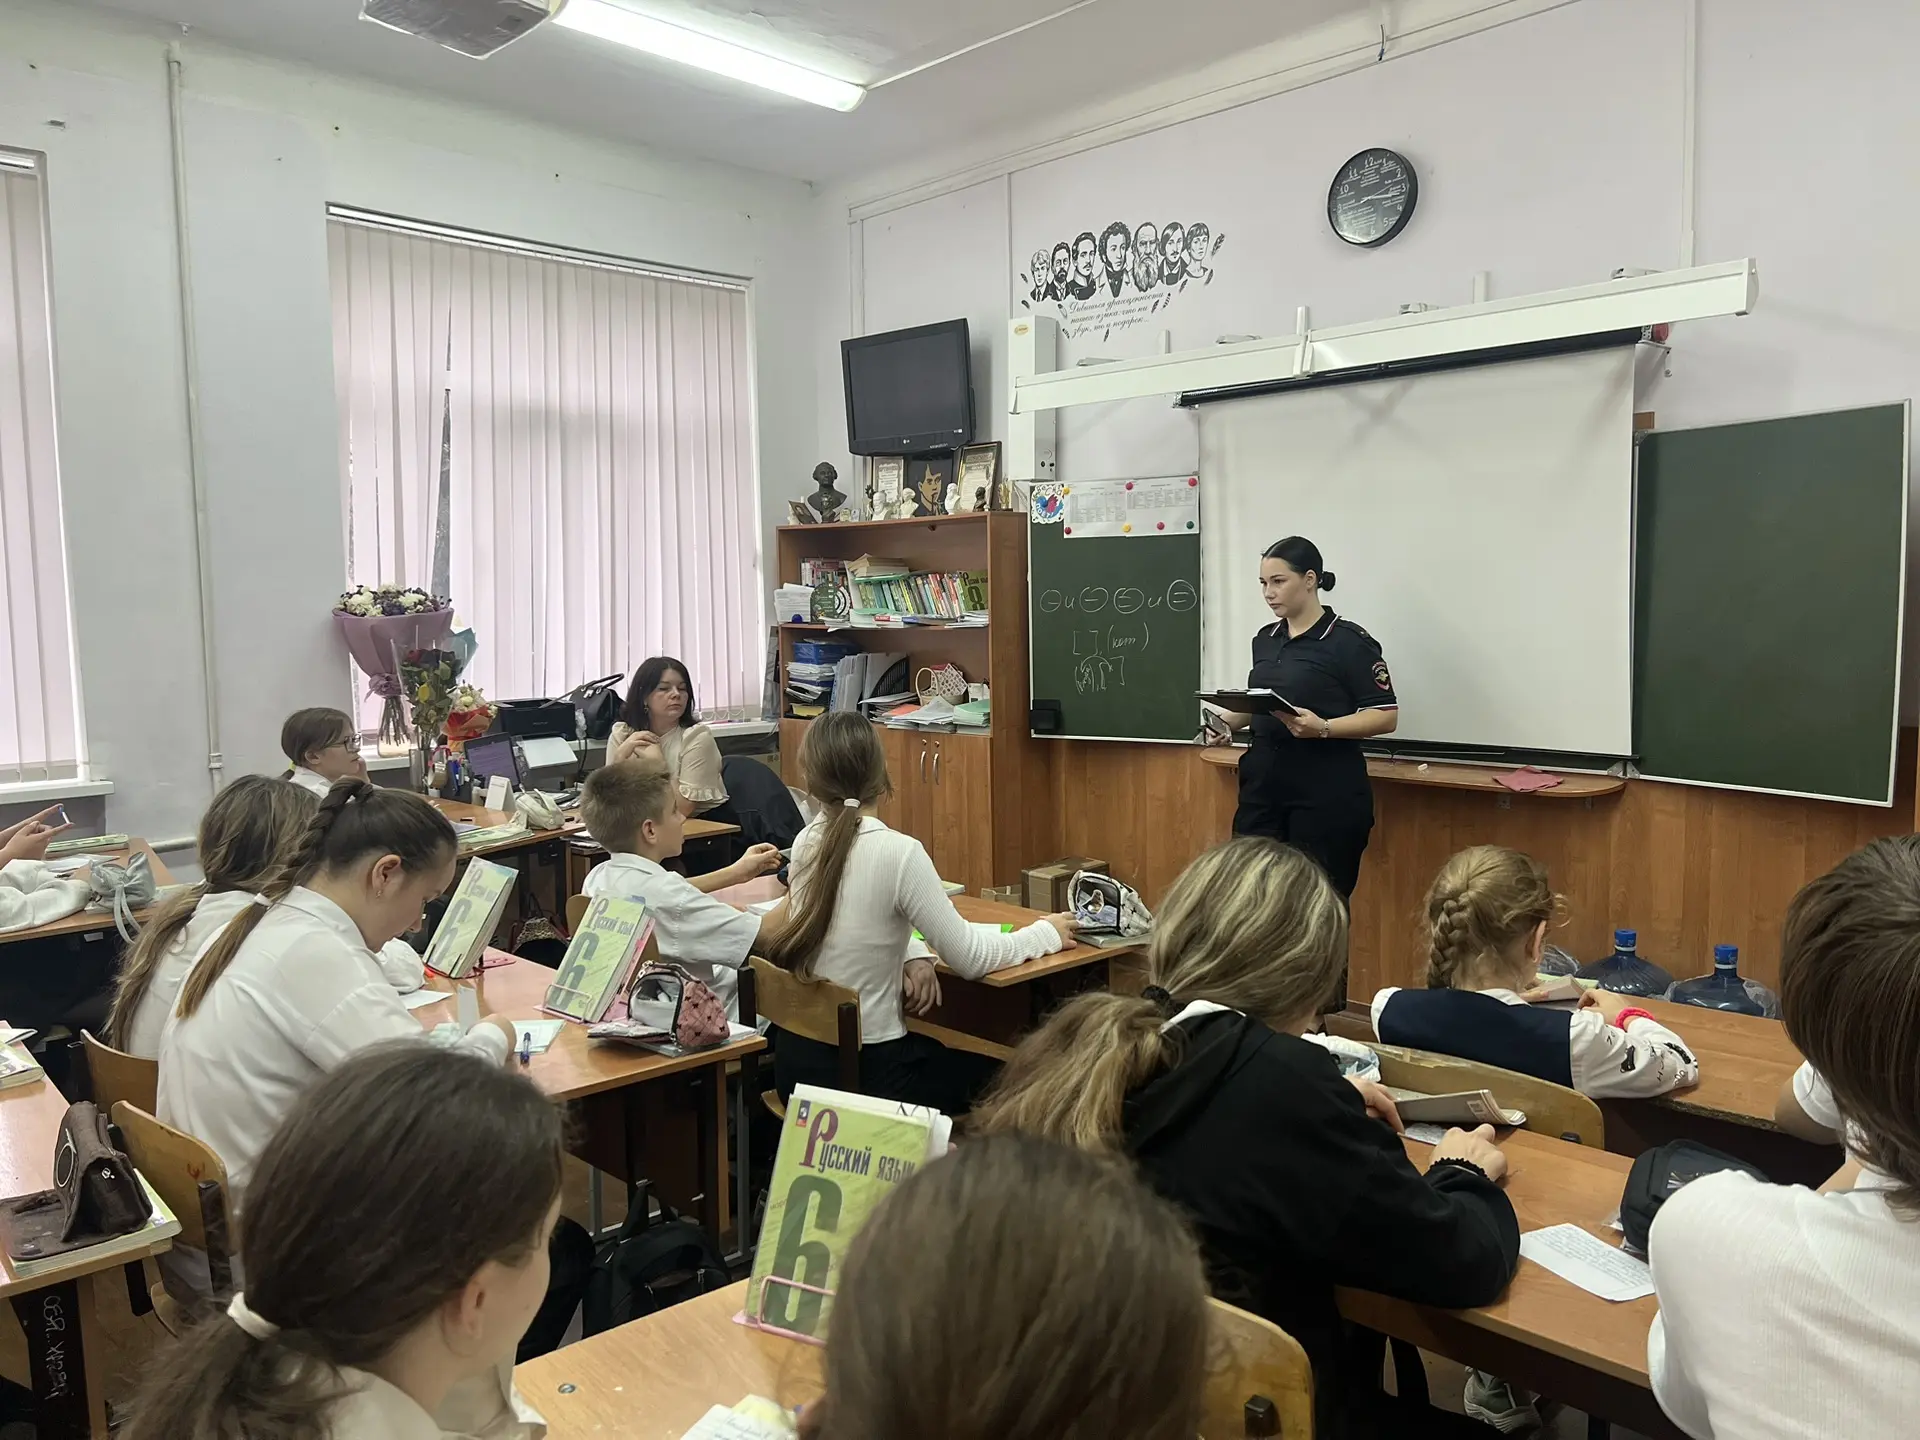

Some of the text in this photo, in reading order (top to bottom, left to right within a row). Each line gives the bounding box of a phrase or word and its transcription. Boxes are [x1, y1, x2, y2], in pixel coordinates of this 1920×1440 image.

[1364, 157, 1374, 169] 12
[1349, 169, 1358, 179] 11
[1340, 184, 1350, 195] 10
[1400, 183, 1406, 192] 3
[1383, 217, 1389, 227] 5
[968, 586, 986, 611] 8
[551, 931, 600, 1010] 6
[799, 1108, 872, 1176] Русский
[763, 1174, 843, 1337] 6
